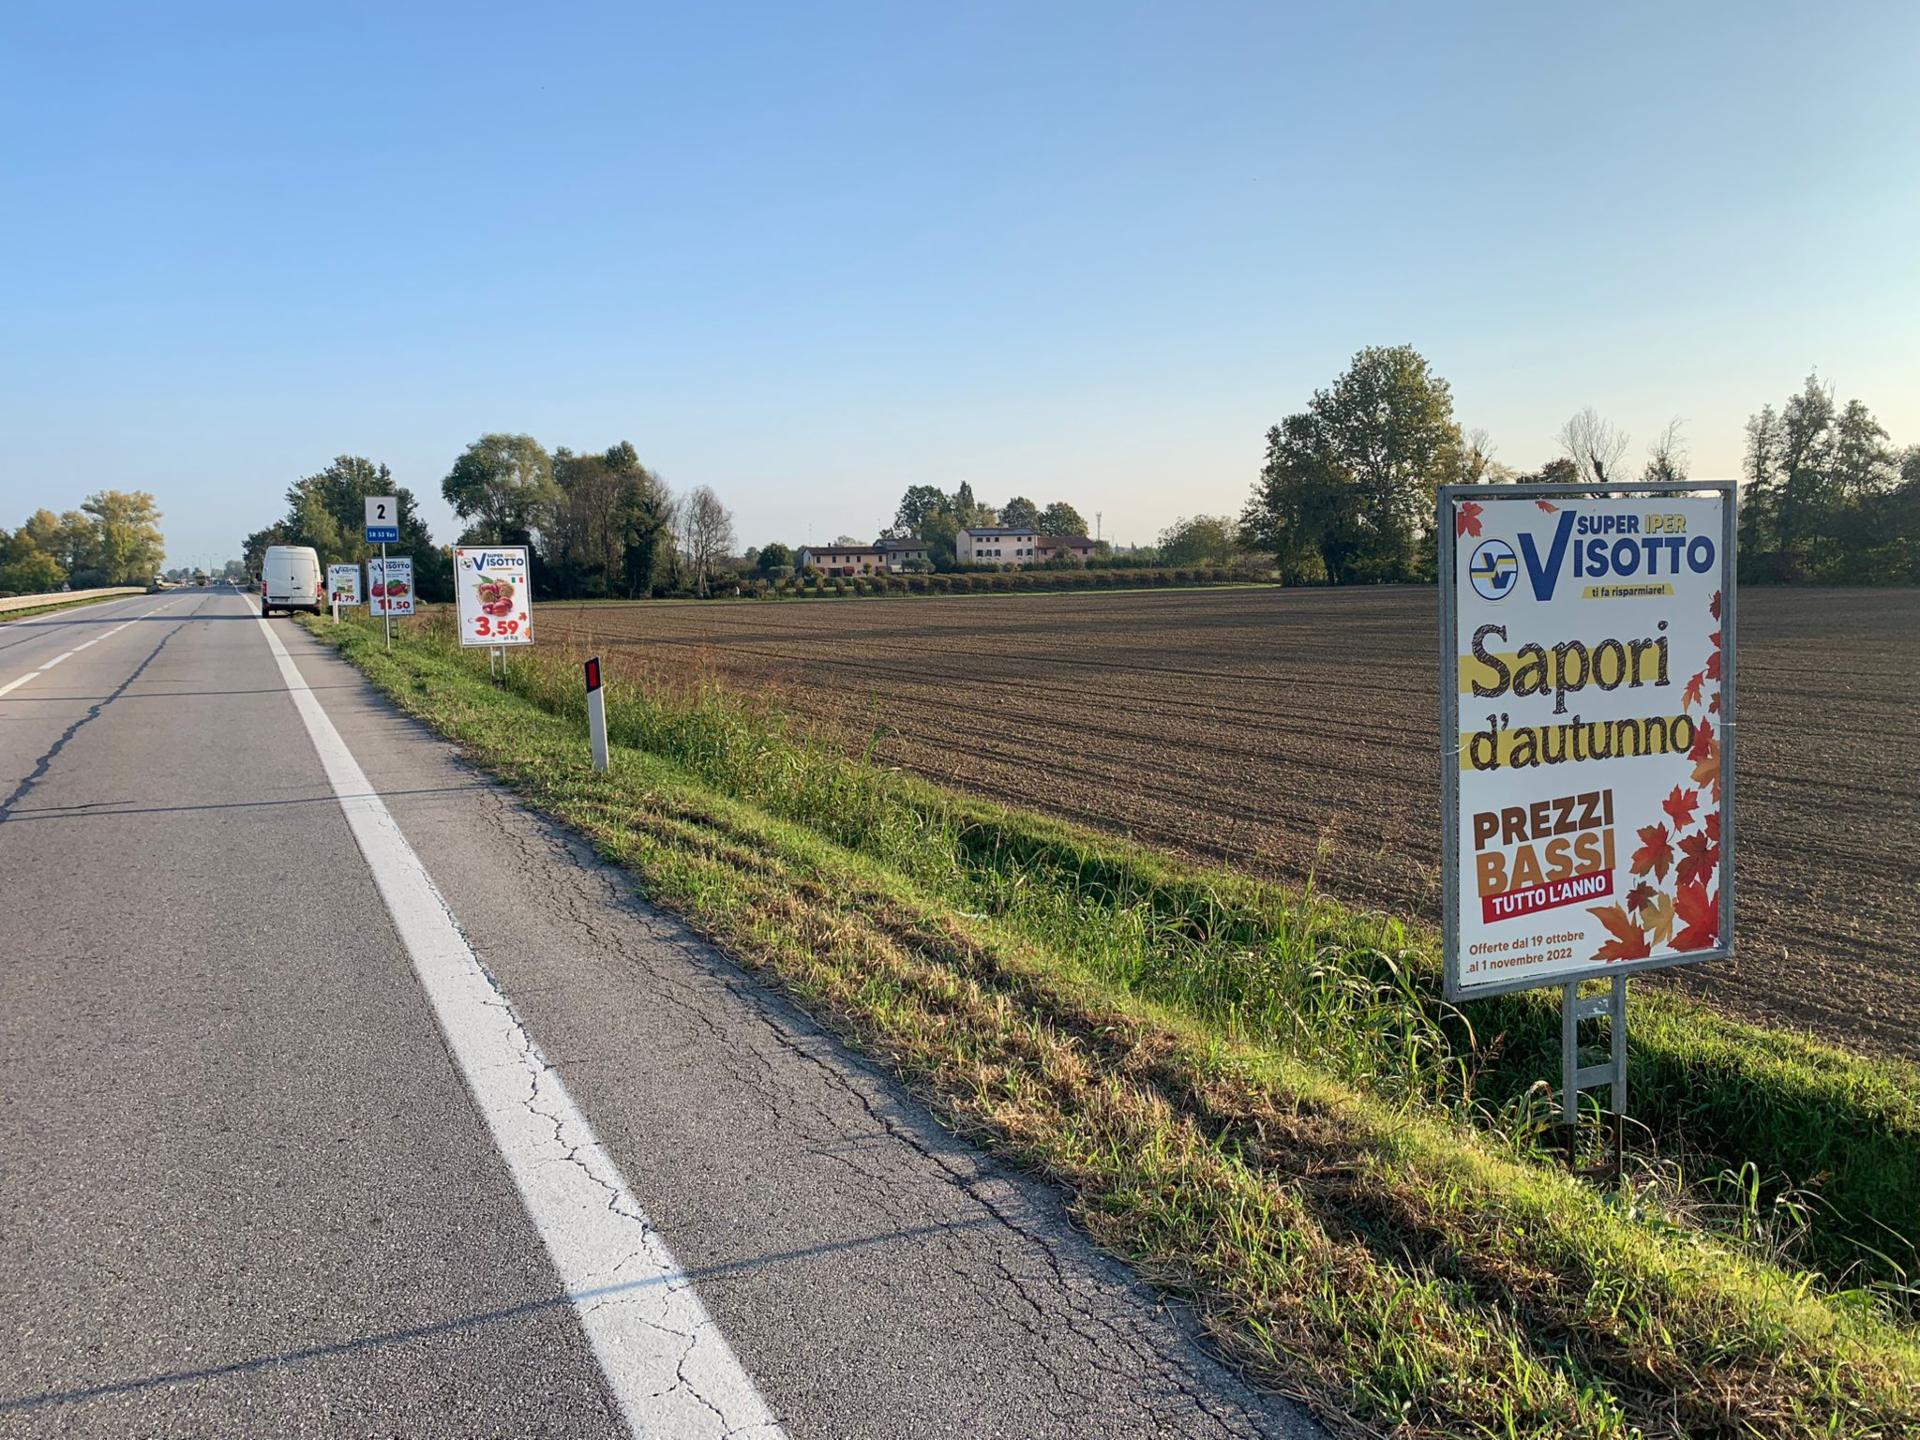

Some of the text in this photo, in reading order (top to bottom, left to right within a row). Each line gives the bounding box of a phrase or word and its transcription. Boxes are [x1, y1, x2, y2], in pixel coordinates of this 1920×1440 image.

[377, 504, 386, 519] 2
[1577, 514, 1687, 535] SUPER IPER
[472, 552, 524, 571] VISOTTO
[1517, 510, 1715, 601] VISOTTO
[1592, 585, 1665, 597] ti fa risparmiare!
[475, 616, 519, 637] 3,59
[1471, 620, 1671, 714] Sapori
[1470, 712, 1695, 771] d'autunno
[1473, 789, 1614, 851] PREZZI
[1476, 828, 1616, 898] BASSI
[1492, 875, 1606, 915] TUTTO L'ANNO
[1469, 931, 1585, 956] Offerte dal 19 ottobre
[1482, 960, 1487, 971] 1
[1490, 954, 1544, 970] novembre
[1546, 947, 1572, 961] 2022
